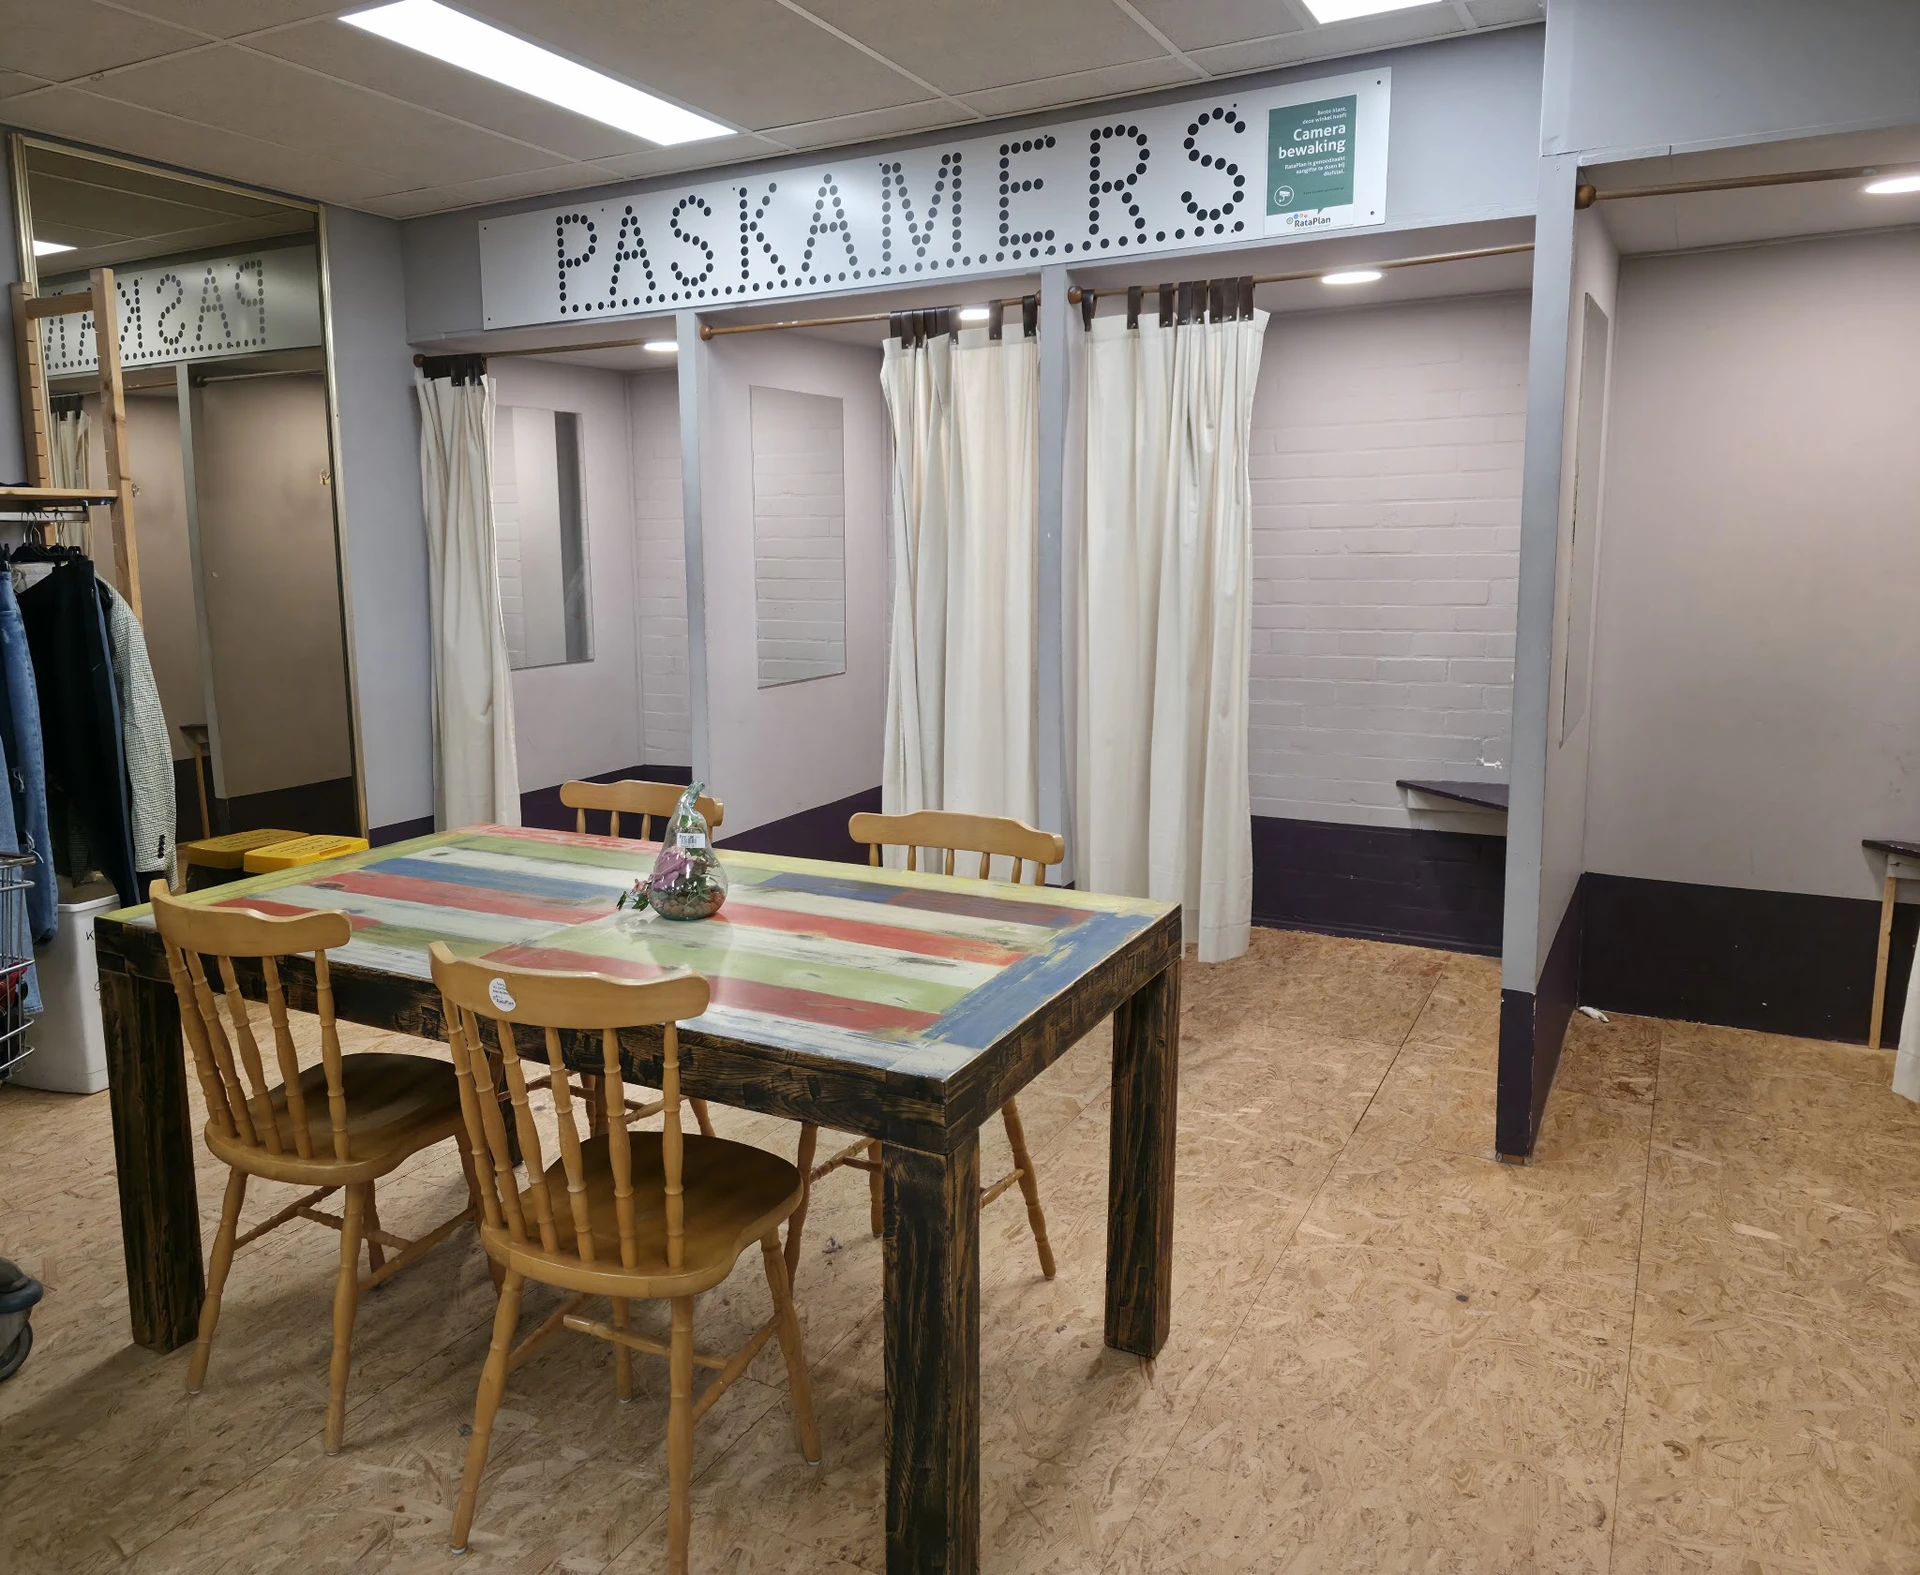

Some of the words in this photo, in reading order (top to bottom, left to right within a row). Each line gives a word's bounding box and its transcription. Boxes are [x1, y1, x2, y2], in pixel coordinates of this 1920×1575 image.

[1293, 124, 1346, 141] Camera
[1278, 139, 1346, 159] bewaking
[1284, 161, 1307, 170] RataPlan
[556, 106, 1247, 314] PASKAMERS
[1294, 217, 1331, 228] RataPlan
